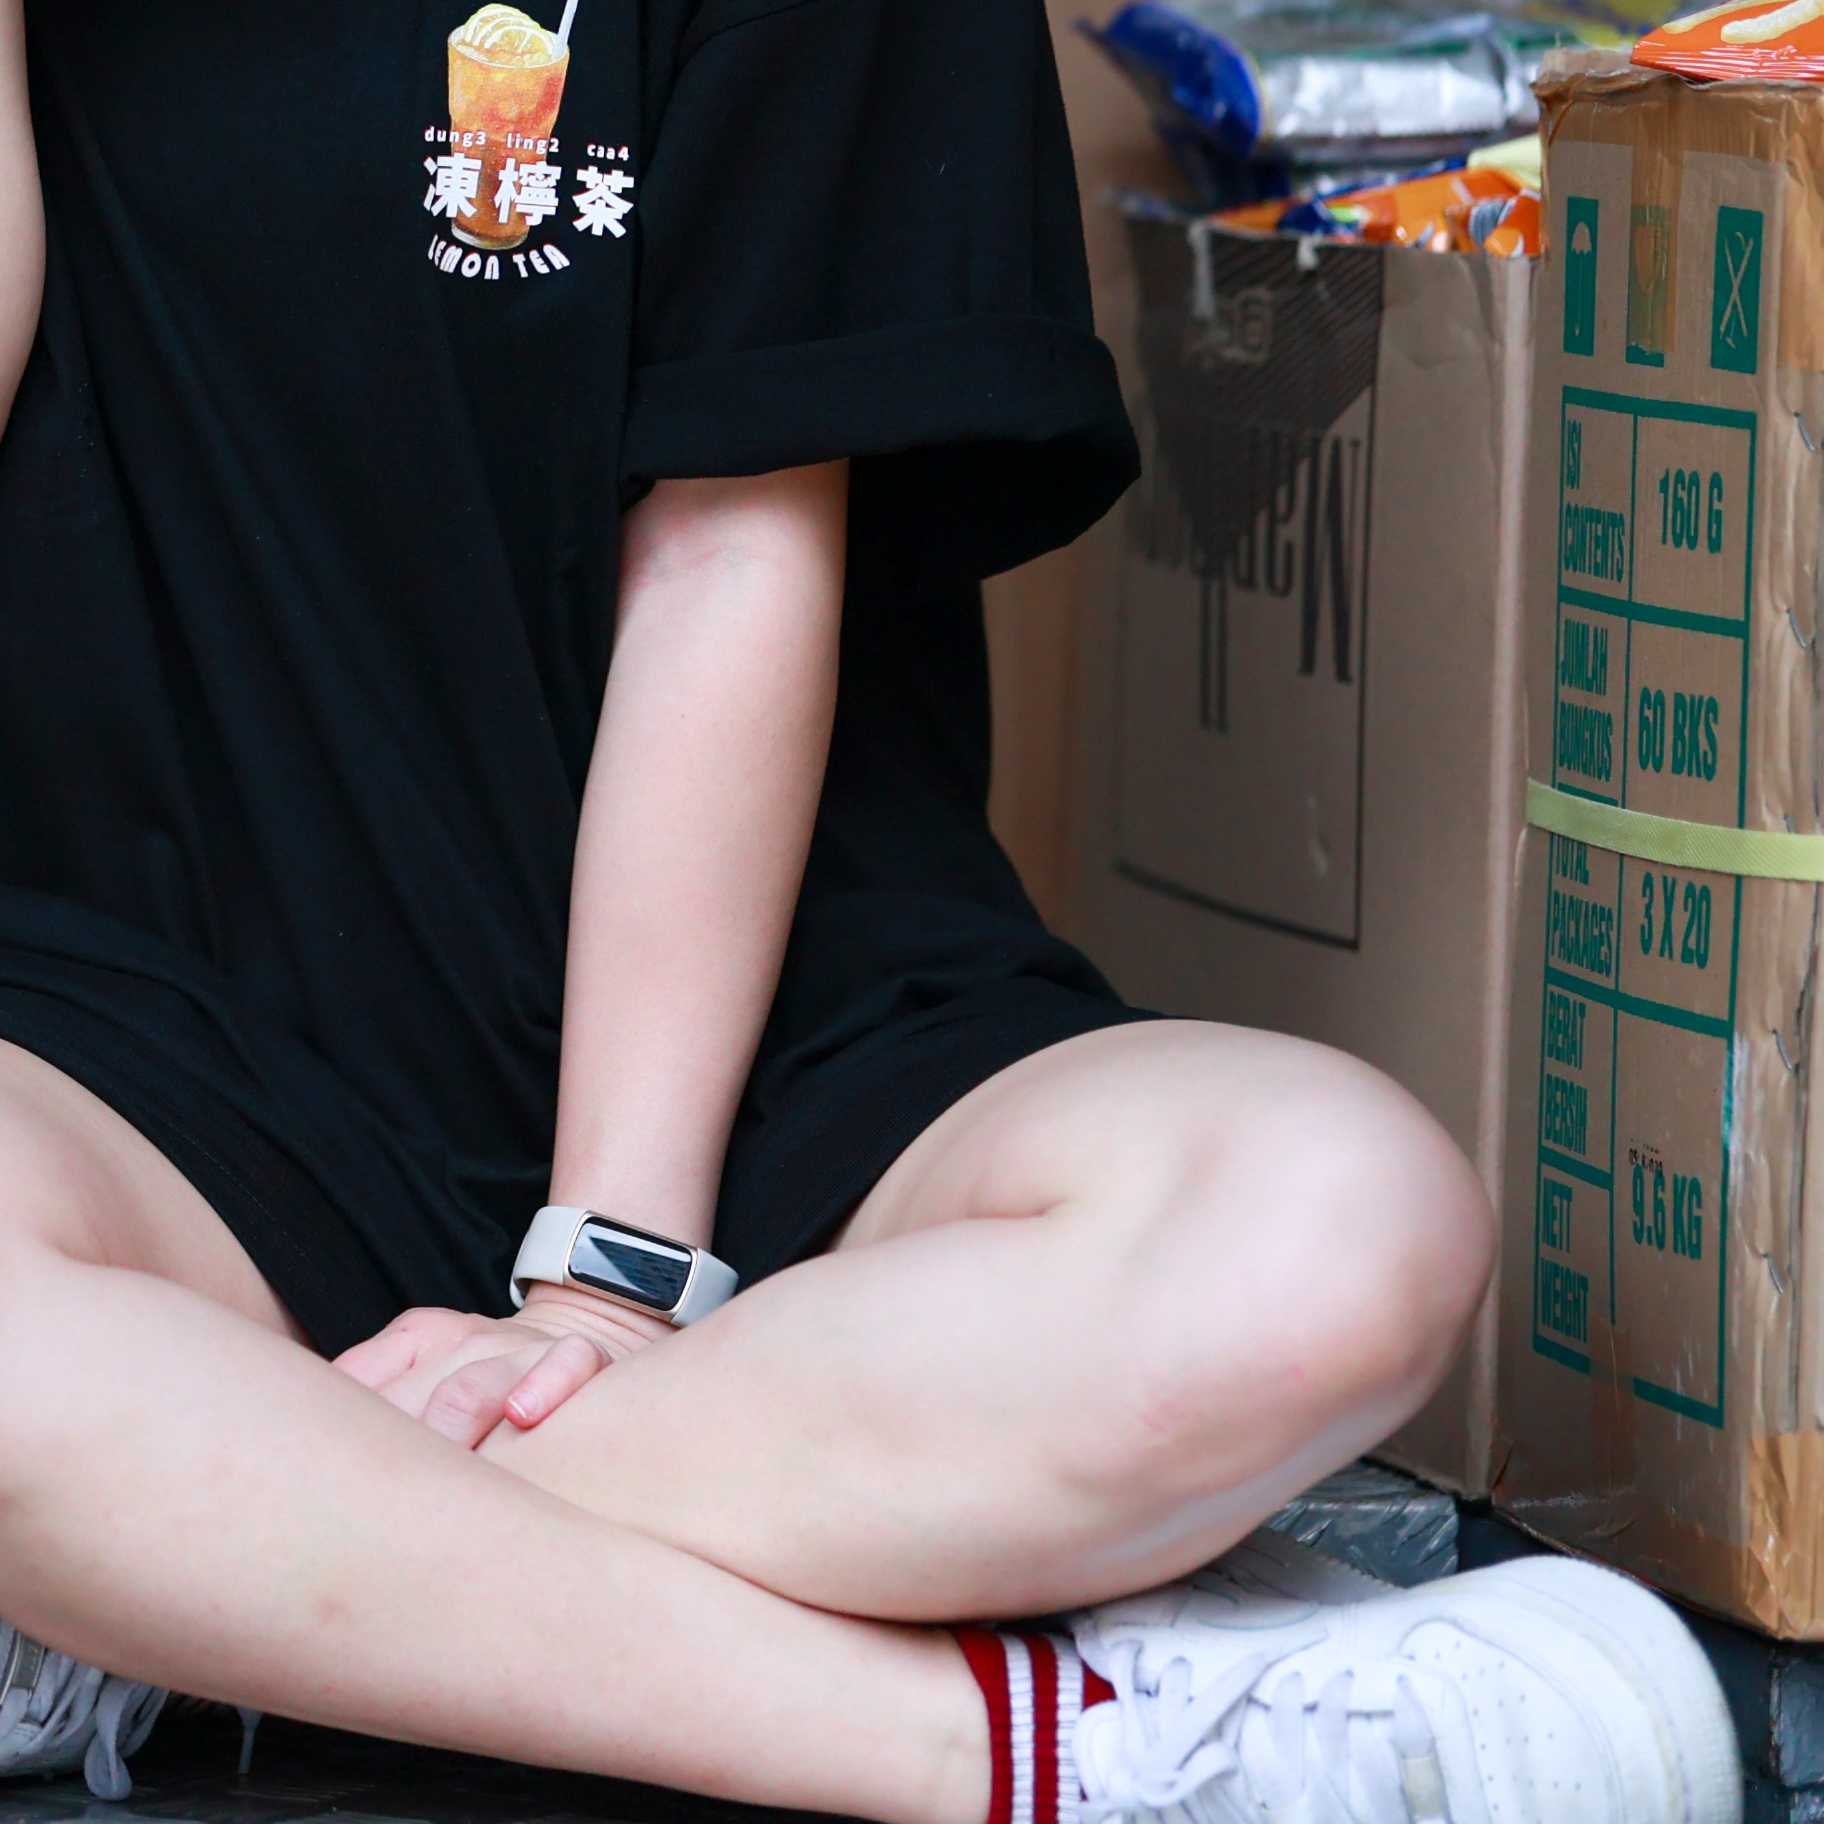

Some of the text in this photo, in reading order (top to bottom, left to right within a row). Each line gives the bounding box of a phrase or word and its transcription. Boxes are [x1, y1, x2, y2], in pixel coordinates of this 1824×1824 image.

[424, 126, 630, 162] dung3 ling2 caa4
[423, 151, 636, 239] 凍檸茶
[427, 233, 571, 280] LEMON TEA
[1564, 501, 1626, 584] CONTENTS
[1659, 467, 1723, 554] 160 G
[1560, 618, 1608, 696] JUMLAH
[1558, 701, 1613, 782] BUNGKUS
[1638, 686, 1719, 782] 60 BKS
[1551, 890, 1614, 978] PACKAGES
[1640, 871, 1711, 970] 3 X 20
[1546, 990, 1586, 1070] BERAT
[1543, 1073, 1588, 1156] BERSIH
[1542, 1177, 1573, 1254] NETT
[1632, 1163, 1702, 1261] 9.6 KG
[1540, 1257, 1589, 1344] WEIGHT
